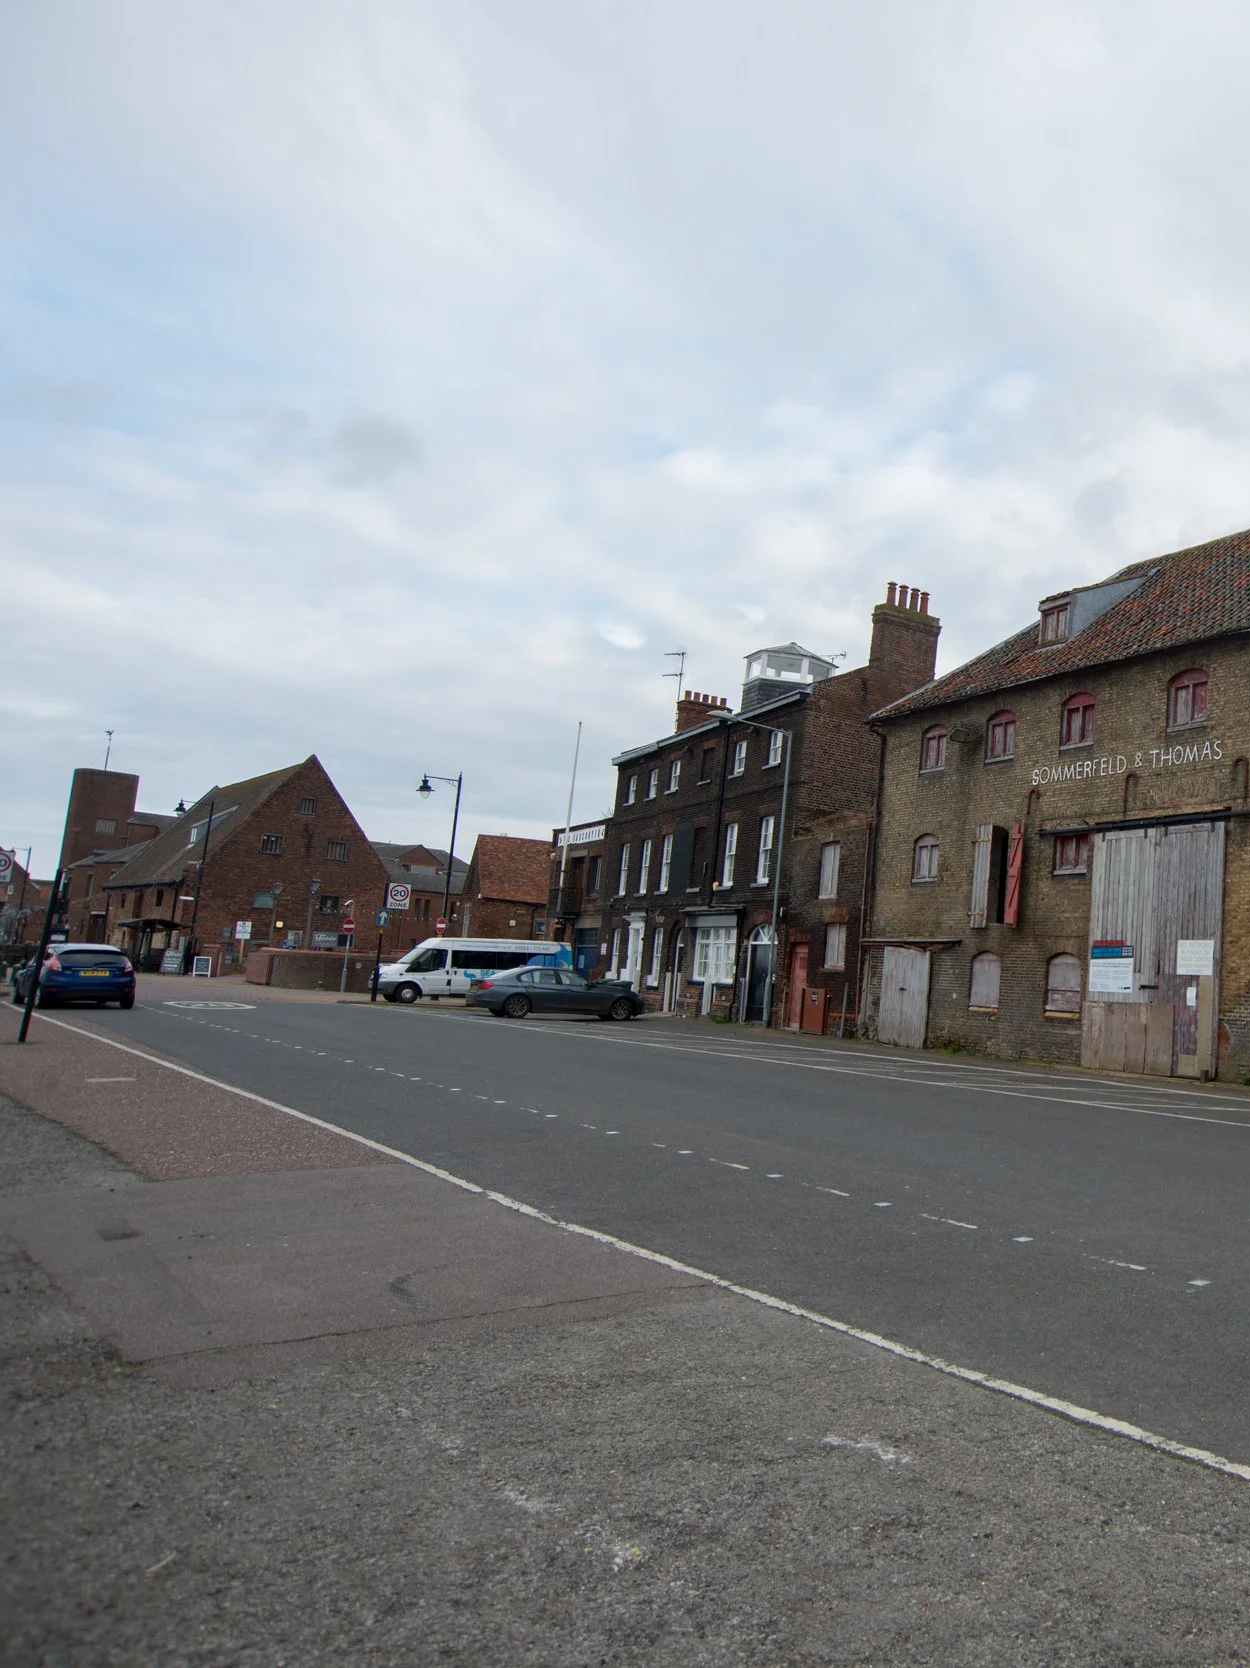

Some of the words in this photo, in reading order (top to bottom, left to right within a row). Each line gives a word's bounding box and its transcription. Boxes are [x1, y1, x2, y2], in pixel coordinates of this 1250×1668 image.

[1032, 755, 1127, 786] SOMMERFELD
[1134, 752, 1143, 768] &
[1149, 740, 1223, 769] THOMAS
[393, 889, 406, 897] 20
